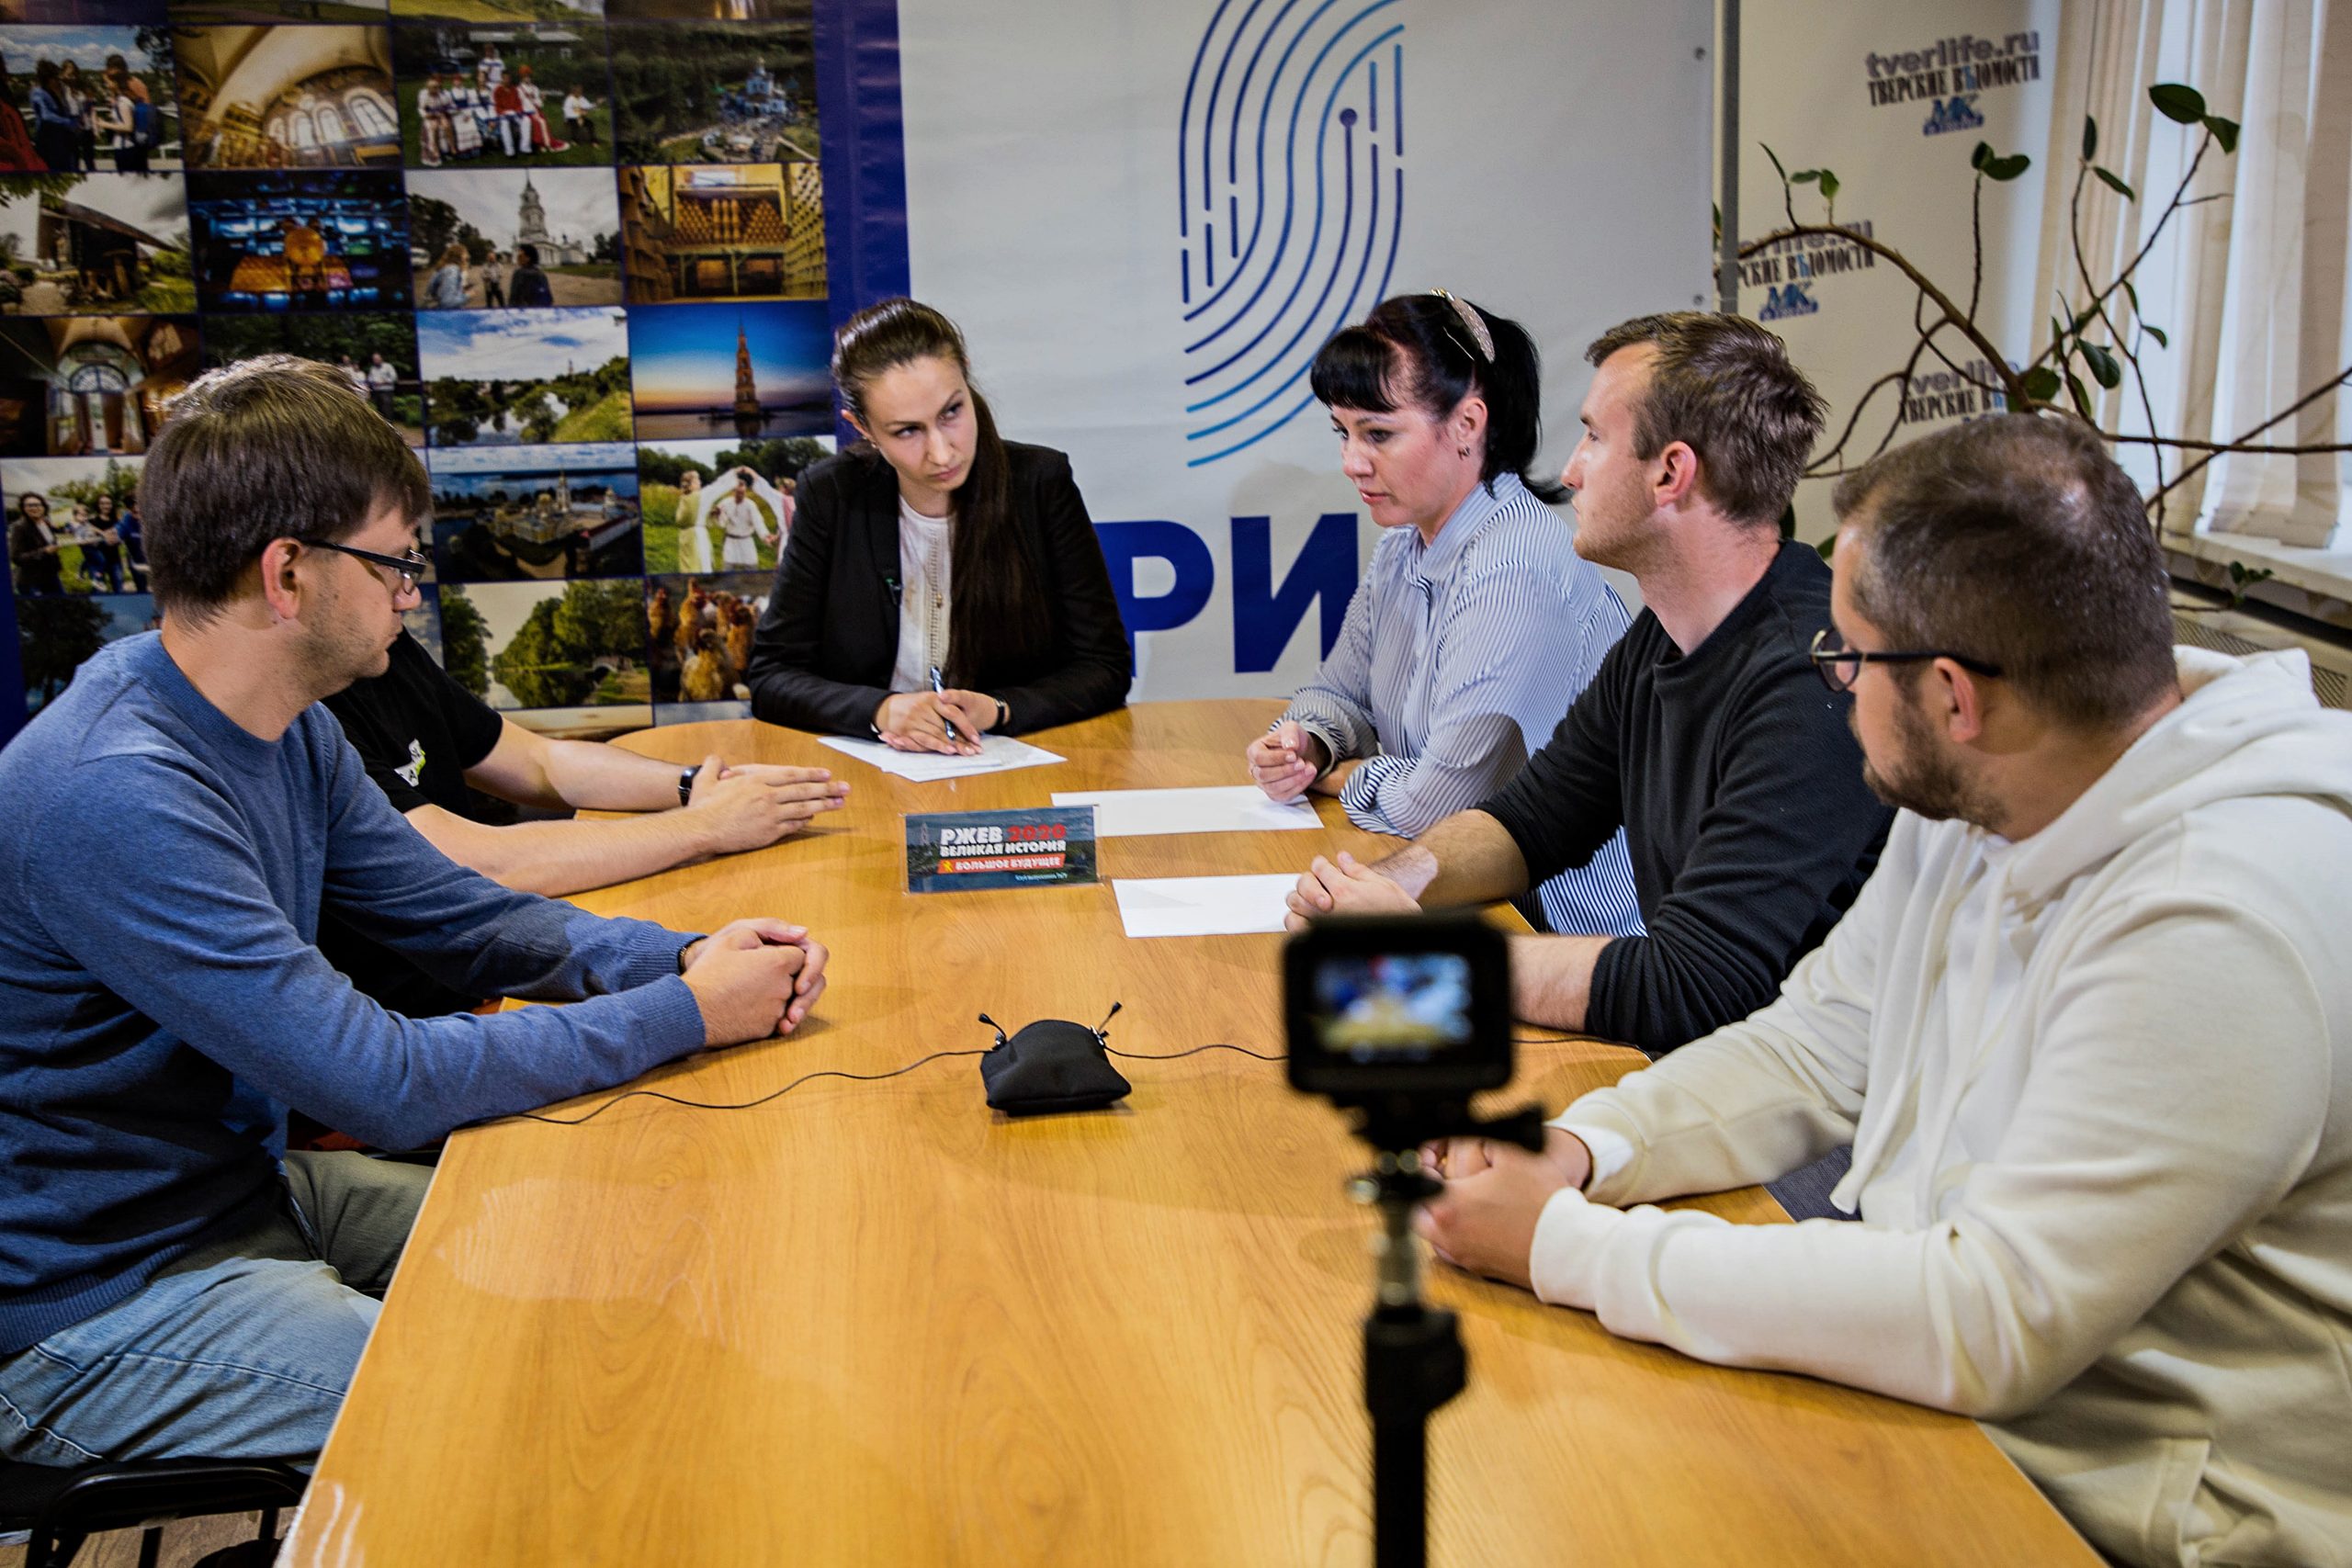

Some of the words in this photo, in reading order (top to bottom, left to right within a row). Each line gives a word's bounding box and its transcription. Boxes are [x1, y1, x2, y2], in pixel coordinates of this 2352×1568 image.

[940, 826, 1003, 845] РЖЕВ
[1007, 822, 1067, 842] 2020
[940, 842, 1004, 857] ВЕЛИКАЯ
[1005, 840, 1067, 854] ИСТОРИЯ
[956, 859, 1010, 871] БОЛЬШОЕ
[1011, 856, 1060, 869] БУДУЩЕЕ
